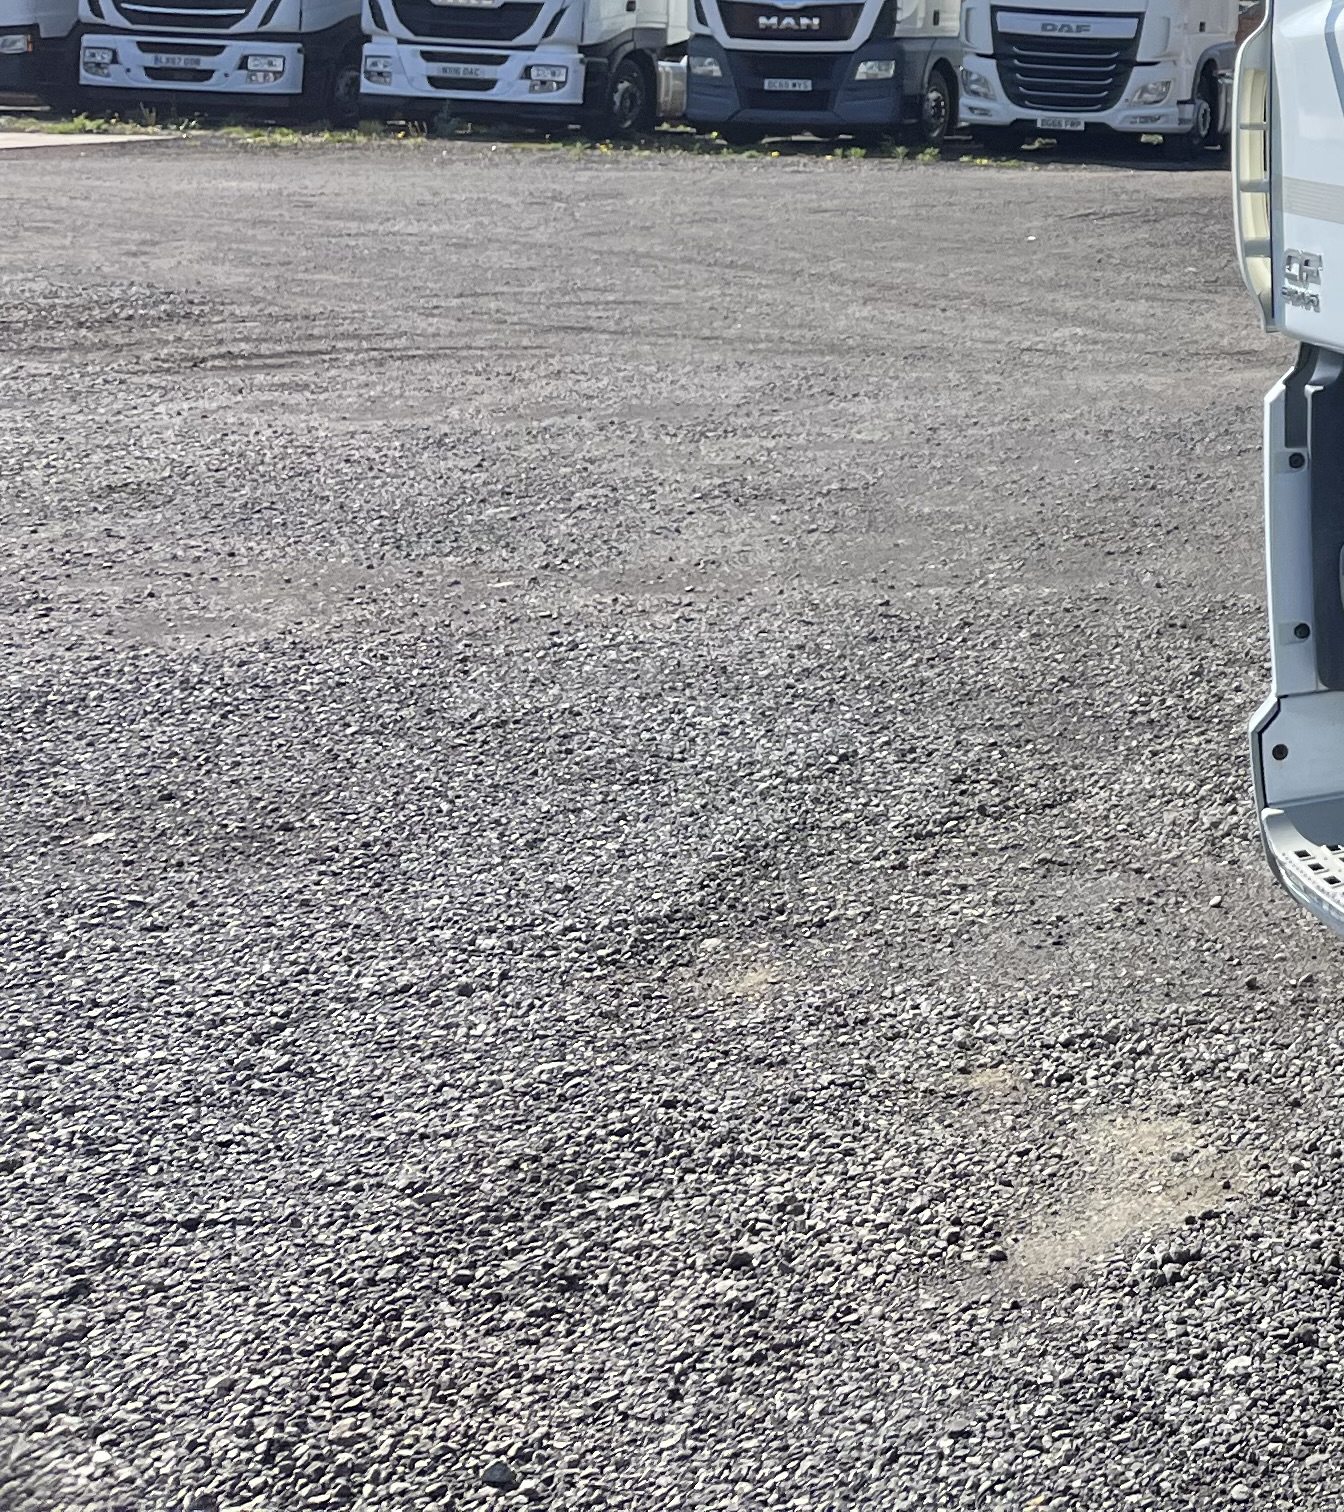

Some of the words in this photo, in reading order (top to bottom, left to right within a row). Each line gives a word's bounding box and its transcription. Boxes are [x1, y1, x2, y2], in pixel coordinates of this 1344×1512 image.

[758, 15, 820, 30] MAN
[1041, 23, 1091, 34] DAF
[1283, 248, 1323, 286] CF
